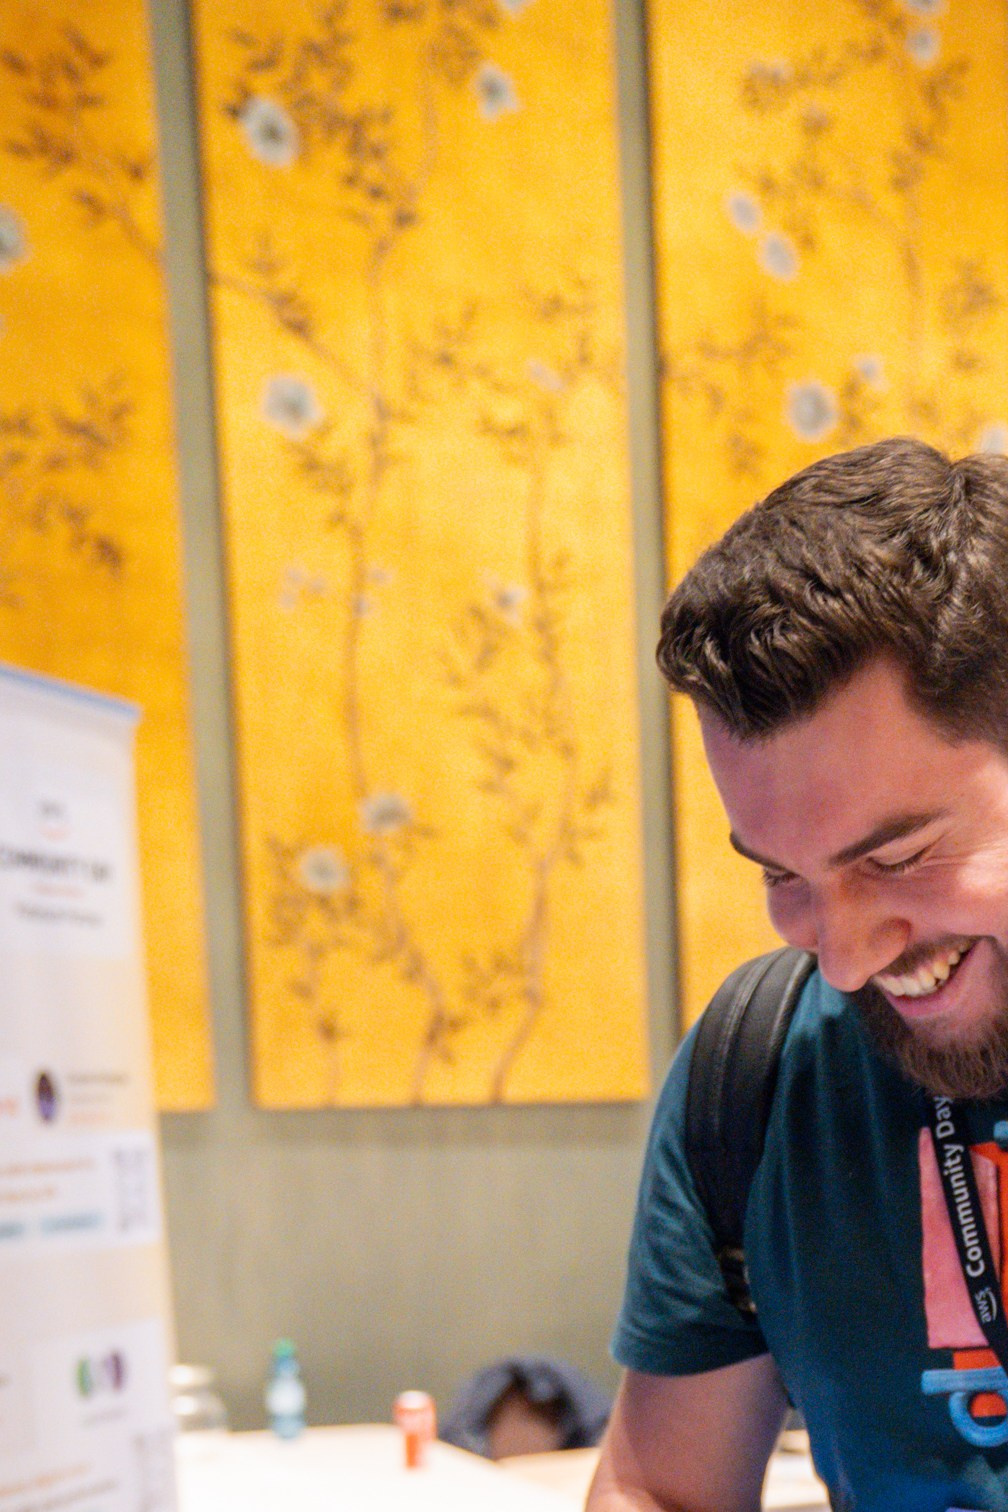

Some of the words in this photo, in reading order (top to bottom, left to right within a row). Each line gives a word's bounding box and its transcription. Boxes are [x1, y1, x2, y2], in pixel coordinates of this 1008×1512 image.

[933, 1095, 956, 1139] Day
[944, 1143, 987, 1277] Community
[975, 1288, 993, 1324] aws
